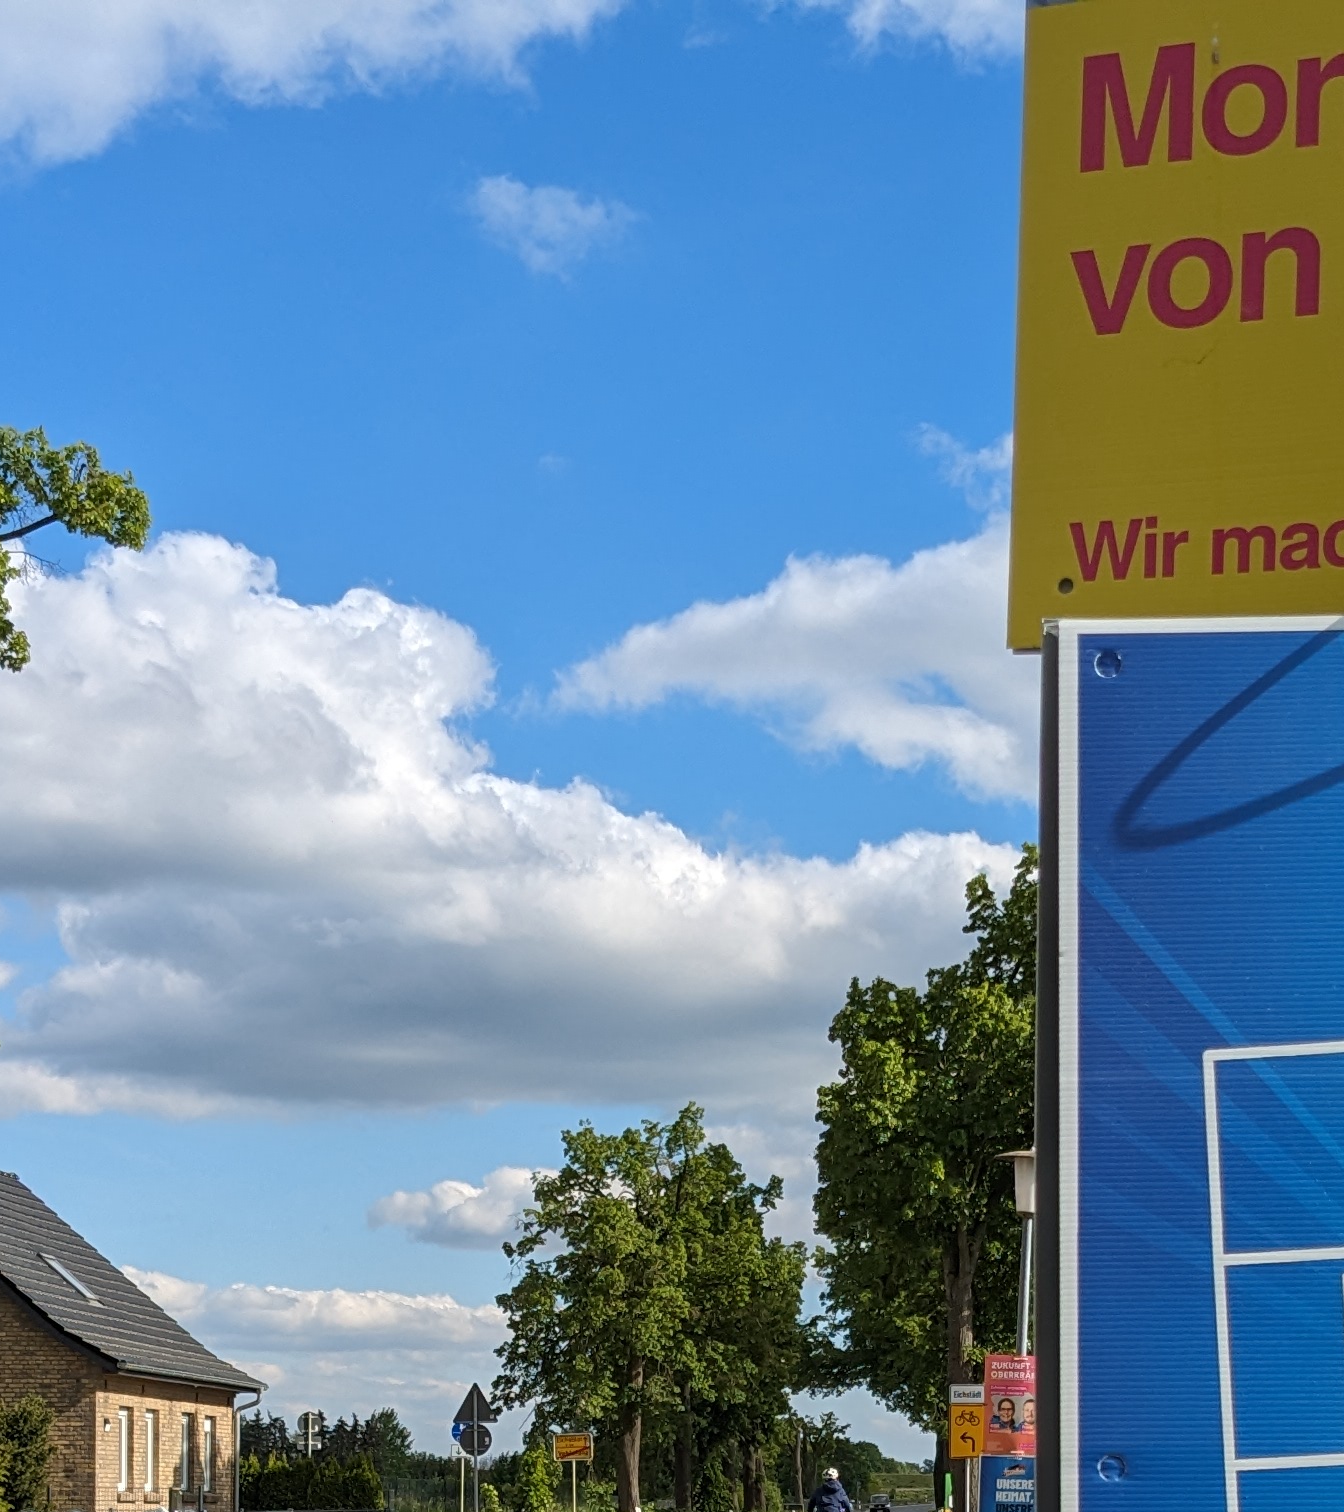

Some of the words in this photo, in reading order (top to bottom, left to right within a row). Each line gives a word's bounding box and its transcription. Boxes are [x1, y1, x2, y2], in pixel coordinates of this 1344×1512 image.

[1070, 221, 1321, 335] von
[1070, 516, 1190, 582] Wir
[996, 1479, 1035, 1490] UNSERE
[996, 1491, 1034, 1504] HEIMAT,
